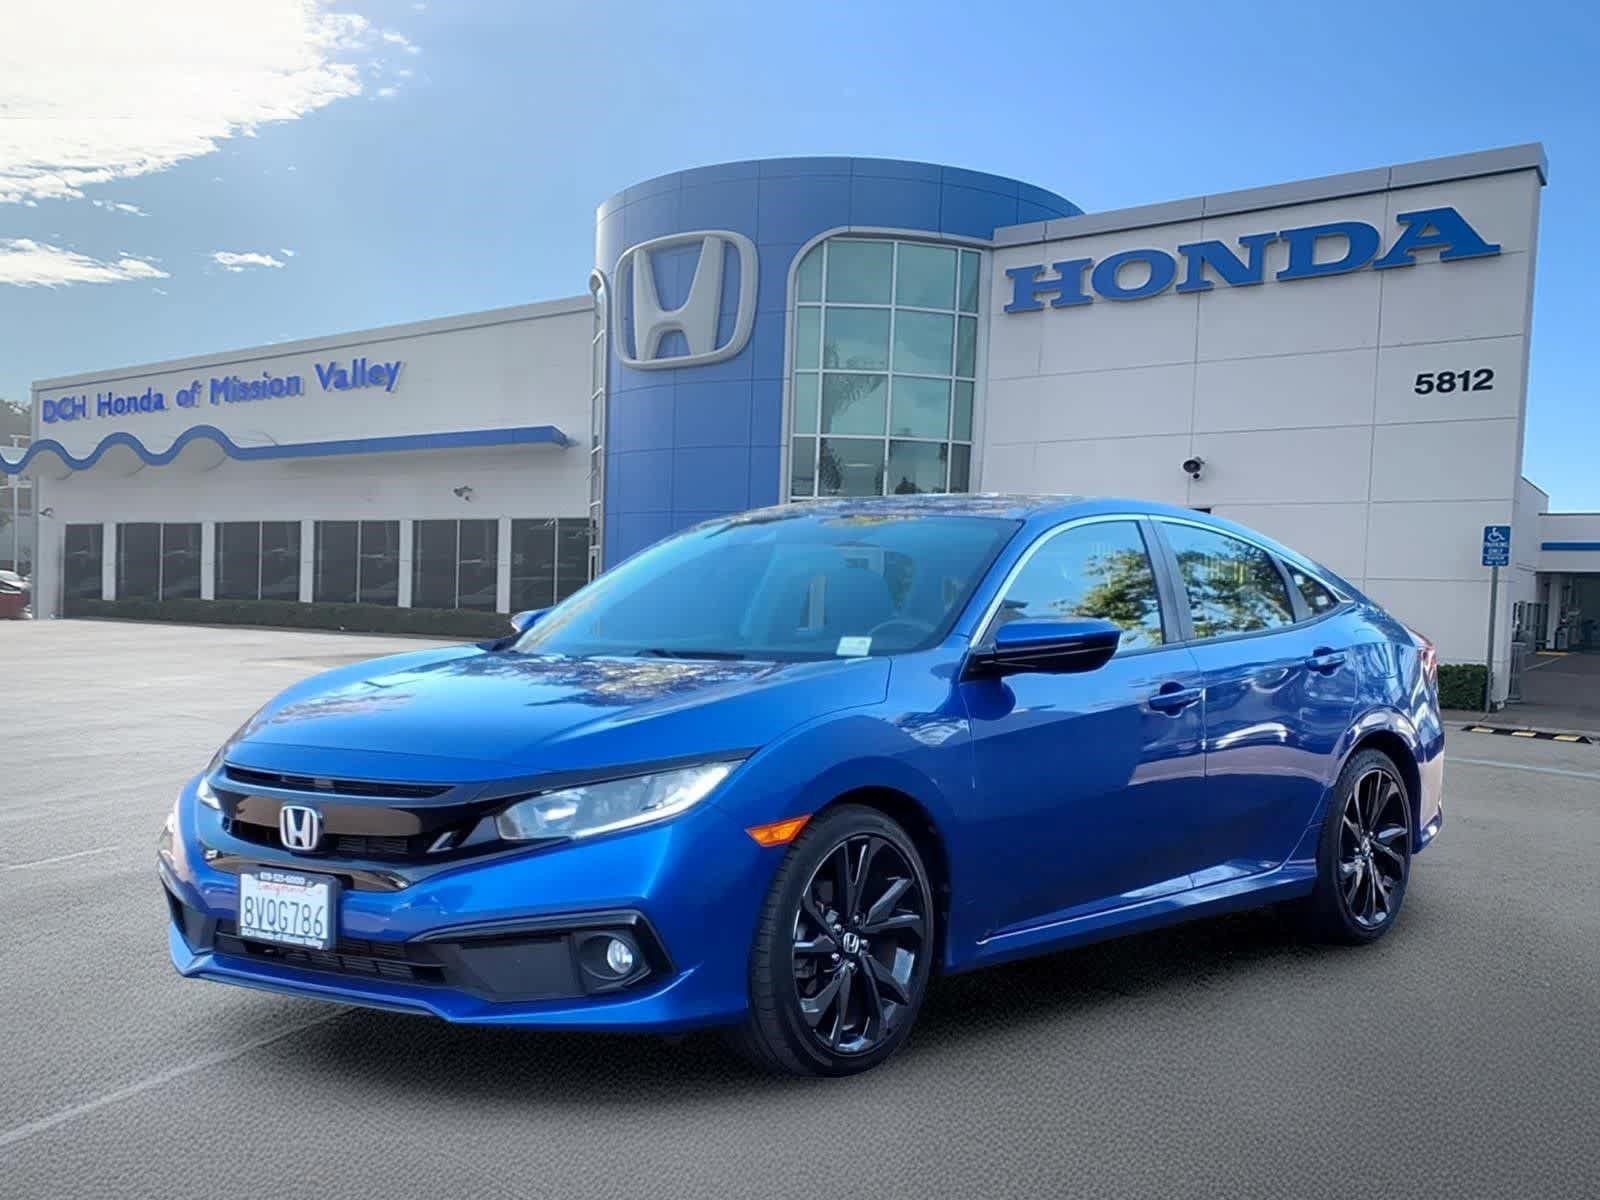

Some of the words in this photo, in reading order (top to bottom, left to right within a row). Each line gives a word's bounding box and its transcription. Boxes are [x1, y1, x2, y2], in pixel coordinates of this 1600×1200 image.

[1003, 206, 1502, 314] HONDA
[42, 395, 87, 424] DCH
[97, 387, 165, 417] Honda
[176, 380, 202, 408] of
[209, 371, 302, 406] Mission
[314, 358, 401, 392] Valley
[1414, 368, 1495, 395] 5812
[244, 896, 324, 936] 8VQG786
